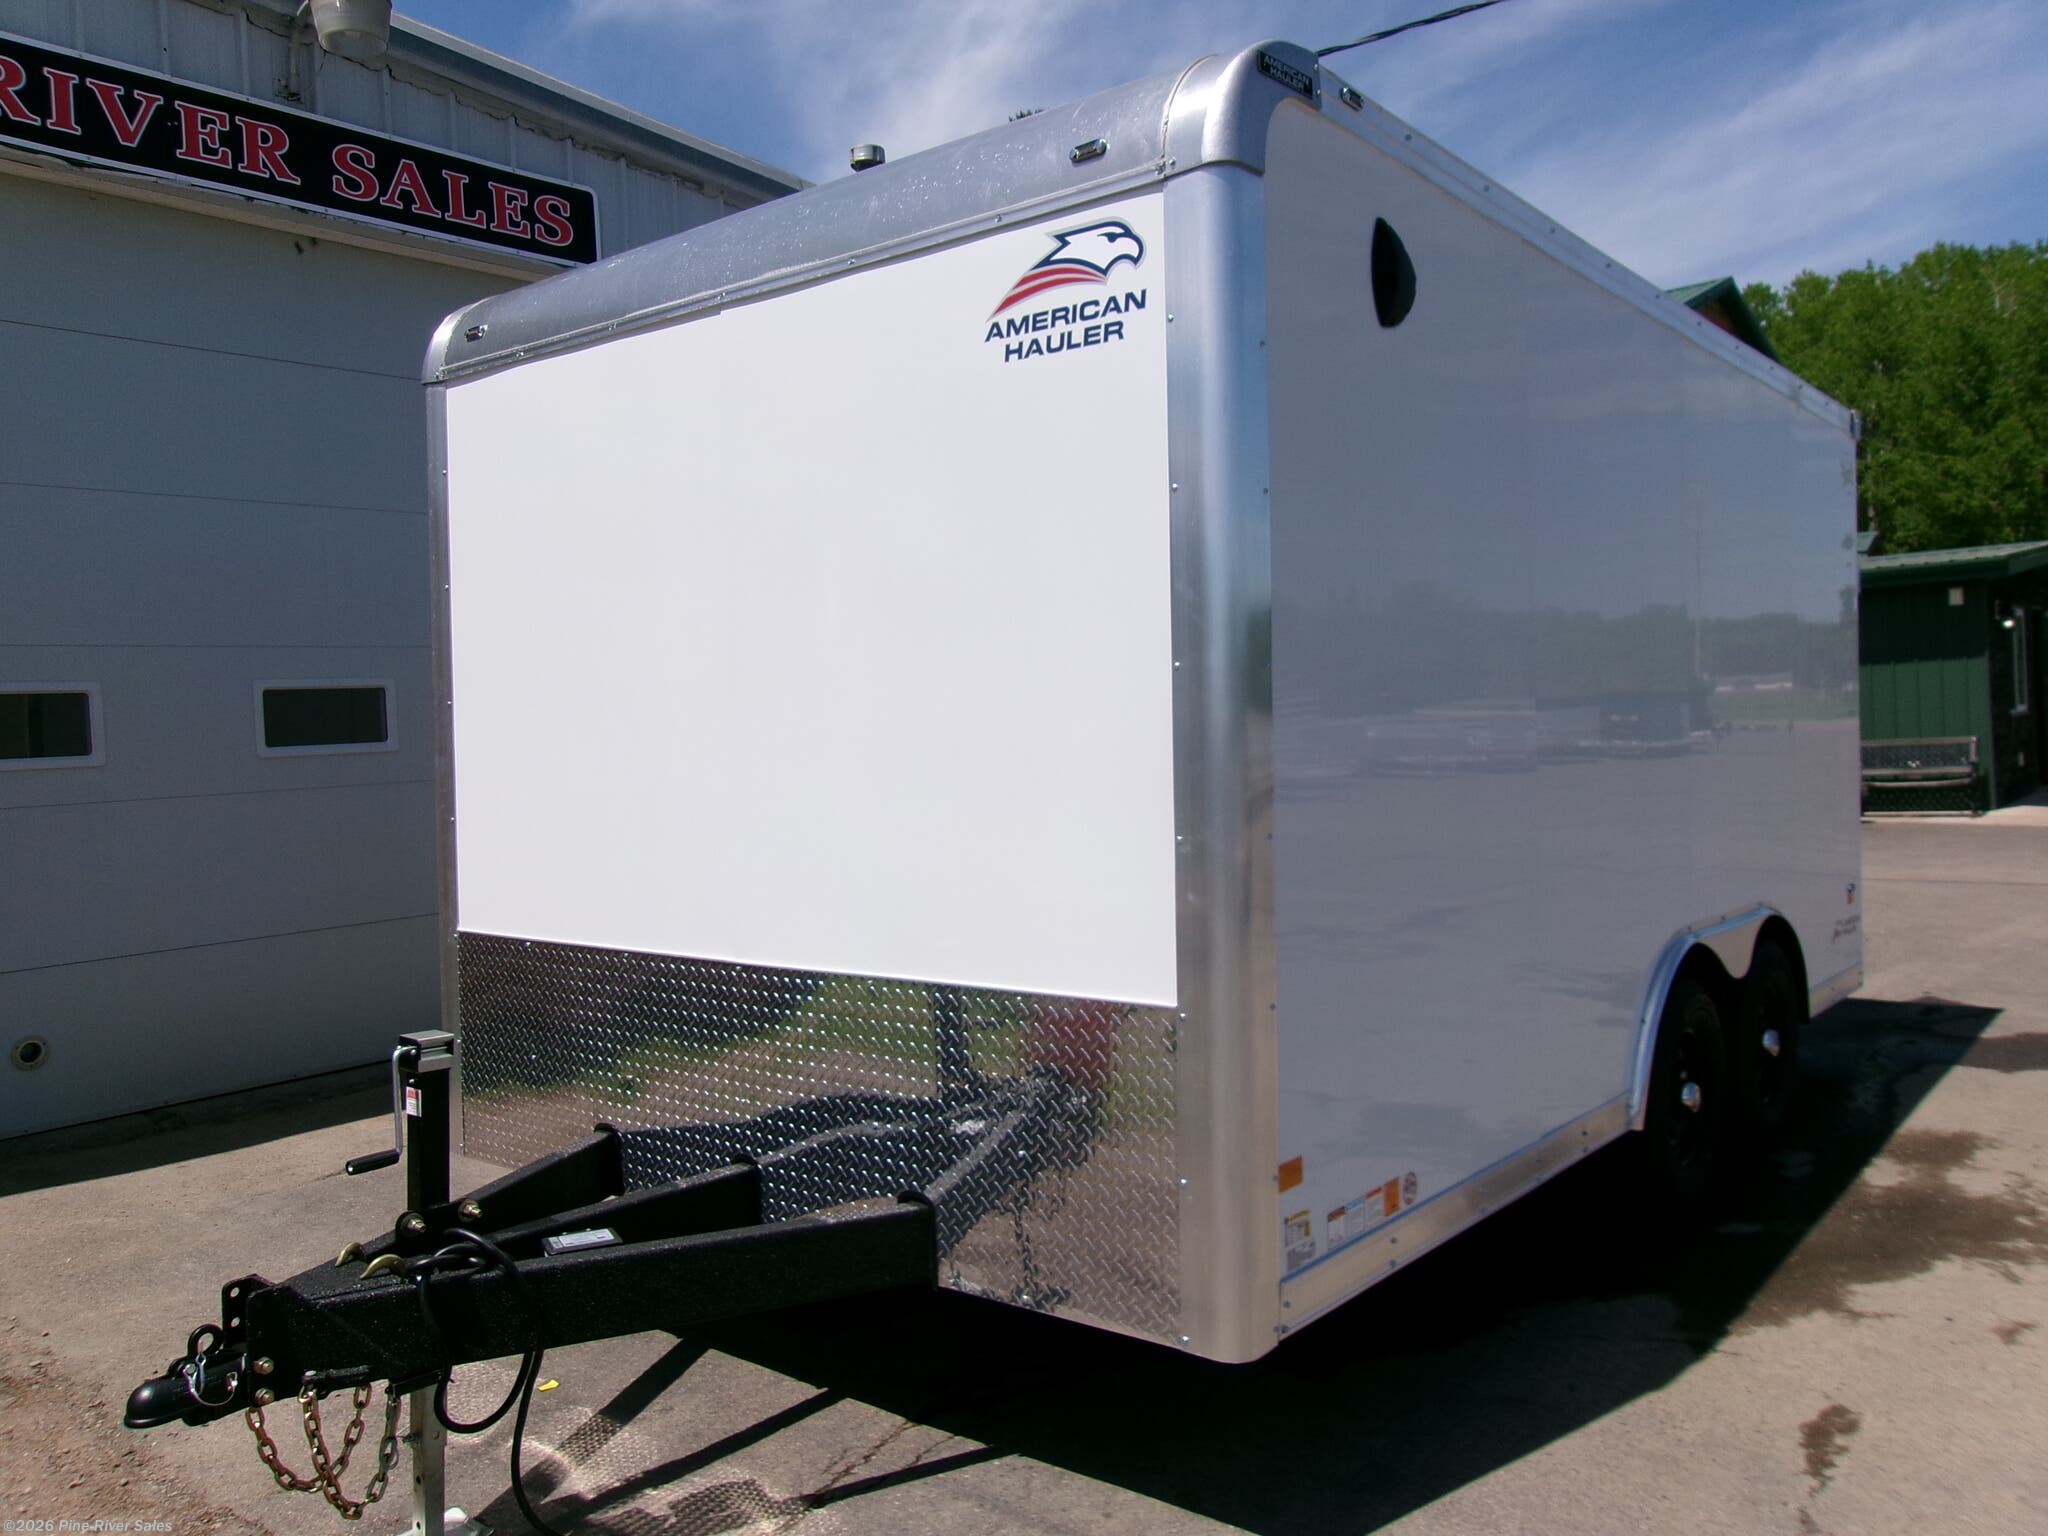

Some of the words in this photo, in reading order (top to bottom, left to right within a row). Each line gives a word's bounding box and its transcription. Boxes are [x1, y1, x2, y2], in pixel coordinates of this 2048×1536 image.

[0, 55, 301, 186] RIVER
[331, 143, 575, 247] SALES
[984, 288, 1147, 344] AMERICAN
[1004, 320, 1125, 363] HAULER
